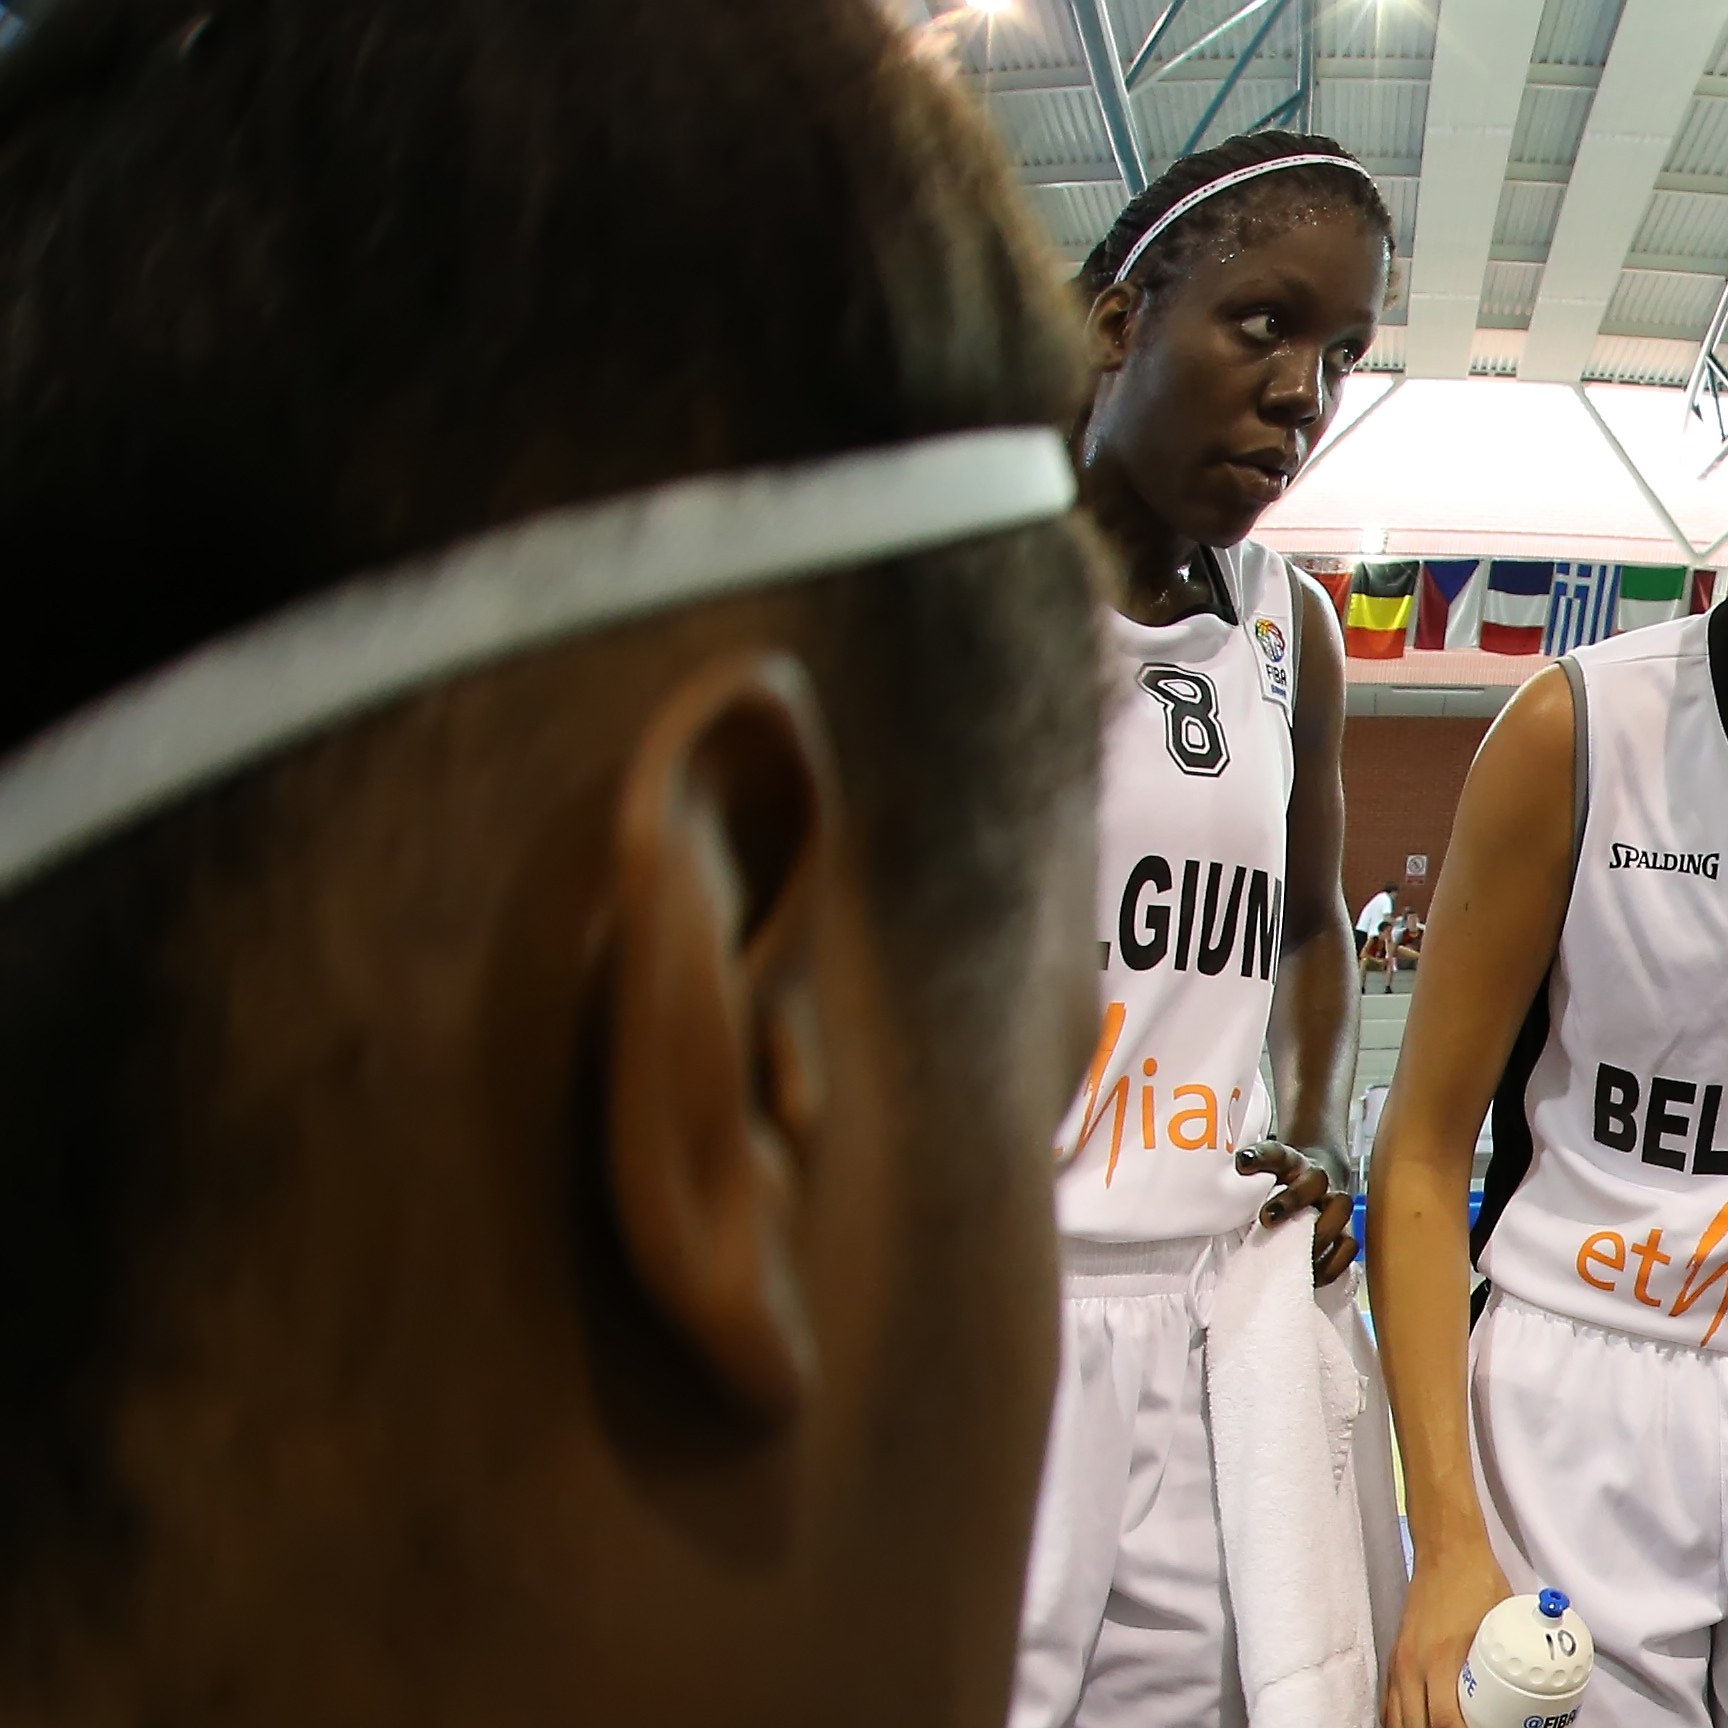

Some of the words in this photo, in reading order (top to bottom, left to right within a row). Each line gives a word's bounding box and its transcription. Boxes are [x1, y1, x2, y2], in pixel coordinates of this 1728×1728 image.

[1135, 662, 1231, 778] 8
[1609, 842, 1720, 881] SPALDING
[1544, 1629, 1577, 1660] 10
